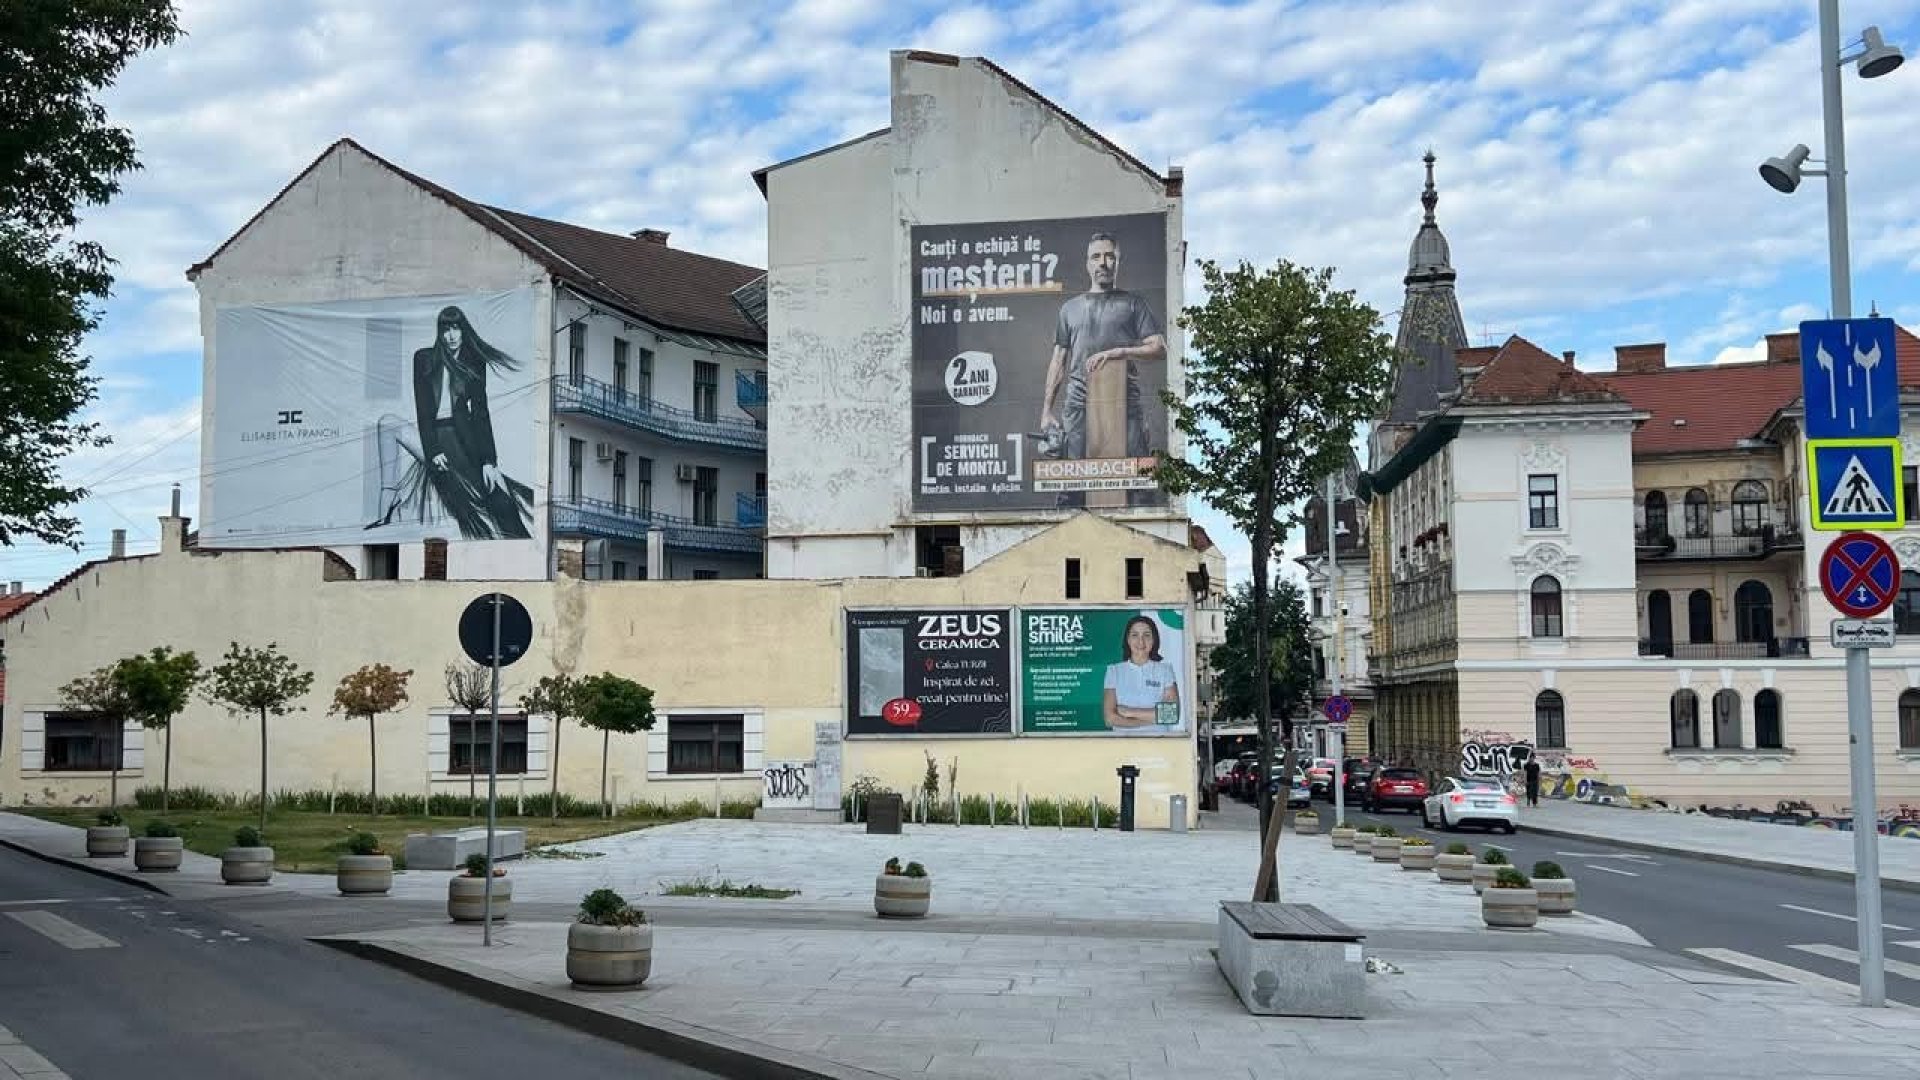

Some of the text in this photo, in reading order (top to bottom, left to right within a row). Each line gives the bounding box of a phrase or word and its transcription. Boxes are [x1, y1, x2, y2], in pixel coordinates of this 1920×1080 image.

[921, 235, 1041, 260] Cauți o echipă de
[921, 253, 1059, 303] meșteri?
[921, 304, 1014, 325] Noi o avem.
[953, 358, 989, 385] 2 ANI
[944, 443, 999, 460] SERVICII
[936, 460, 1007, 477] DE MONTAJ
[1035, 459, 1135, 477] HORNBACH
[917, 614, 1001, 637] ZEUS
[1028, 614, 1083, 631] PETRA
[918, 638, 1001, 650] CERAMICA
[1028, 627, 1084, 644] smiles
[923, 676, 962, 689] Inspirat
[964, 676, 978, 687] de
[916, 692, 943, 703] creat
[945, 693, 982, 706] pentru
[892, 703, 910, 715] 59
